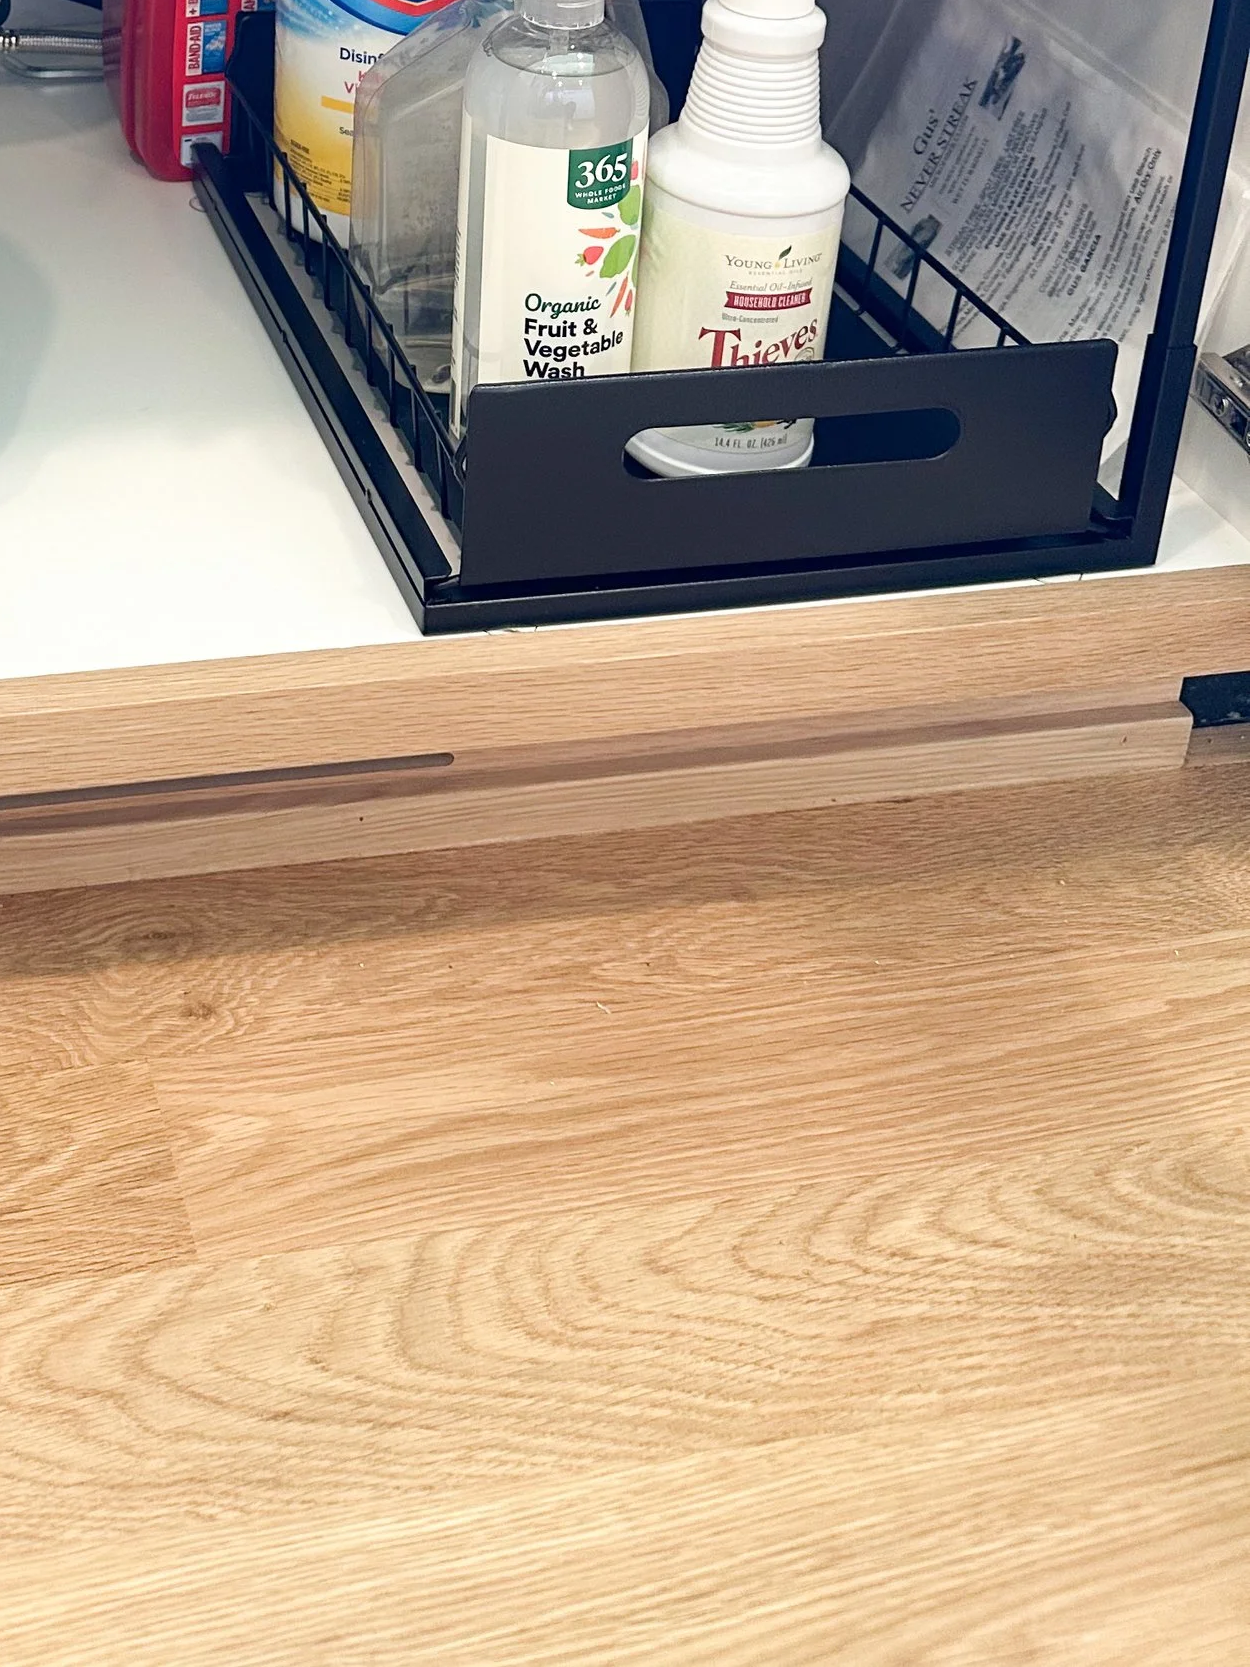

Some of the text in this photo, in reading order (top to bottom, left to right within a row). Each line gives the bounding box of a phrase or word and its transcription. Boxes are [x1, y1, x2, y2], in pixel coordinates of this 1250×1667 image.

[187, 25, 202, 70] BAND-AID
[339, 47, 385, 65] Disinf
[900, 152, 942, 214] NEVER
[937, 79, 978, 151] STREAK
[574, 152, 629, 190] 365
[574, 189, 603, 199] WHOLE
[586, 193, 618, 205] MARKET
[729, 280, 768, 293] Essential
[524, 292, 602, 319] Organic
[733, 292, 807, 309] HOUSEHOLD CLEANER
[524, 317, 599, 338] Fruit &
[721, 312, 779, 324] Ultra-Concentrated
[523, 329, 624, 363] Vegetable
[698, 318, 819, 369] Thieves
[522, 359, 586, 380] Wash
